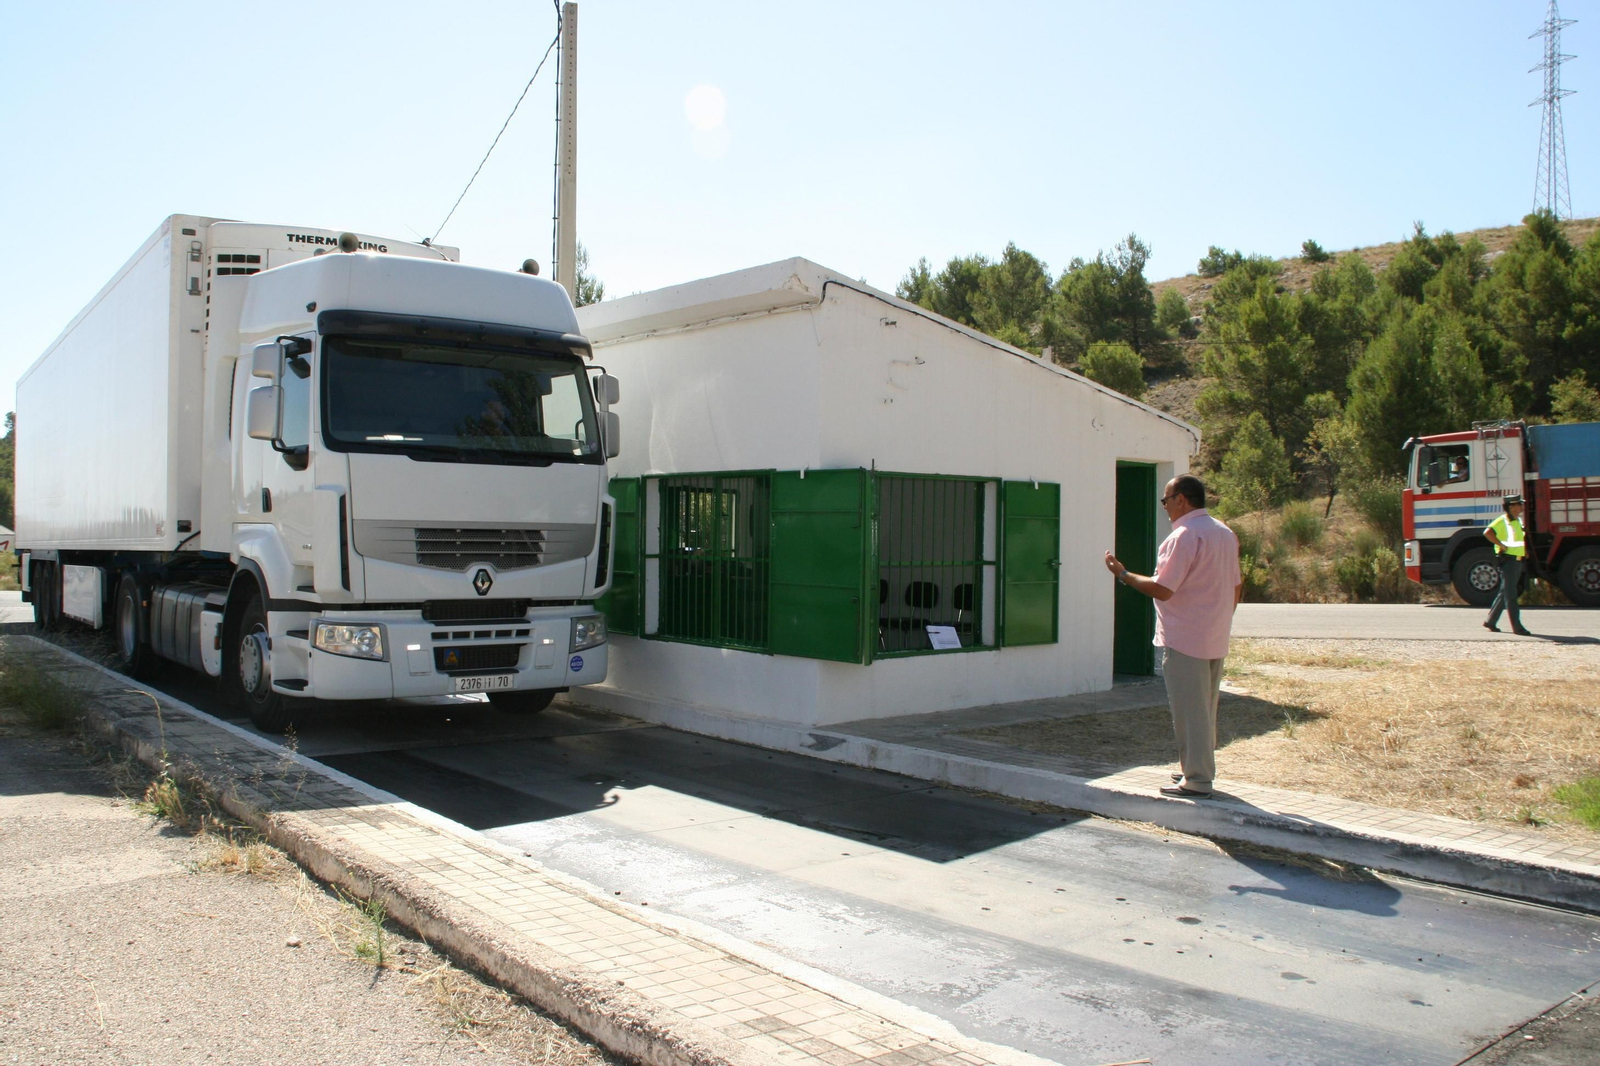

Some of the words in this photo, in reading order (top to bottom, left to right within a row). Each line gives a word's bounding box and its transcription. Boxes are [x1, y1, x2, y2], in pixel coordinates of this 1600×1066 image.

[286, 233, 346, 247] THERM
[460, 678, 482, 690] 2376
[497, 676, 509, 687] 70
